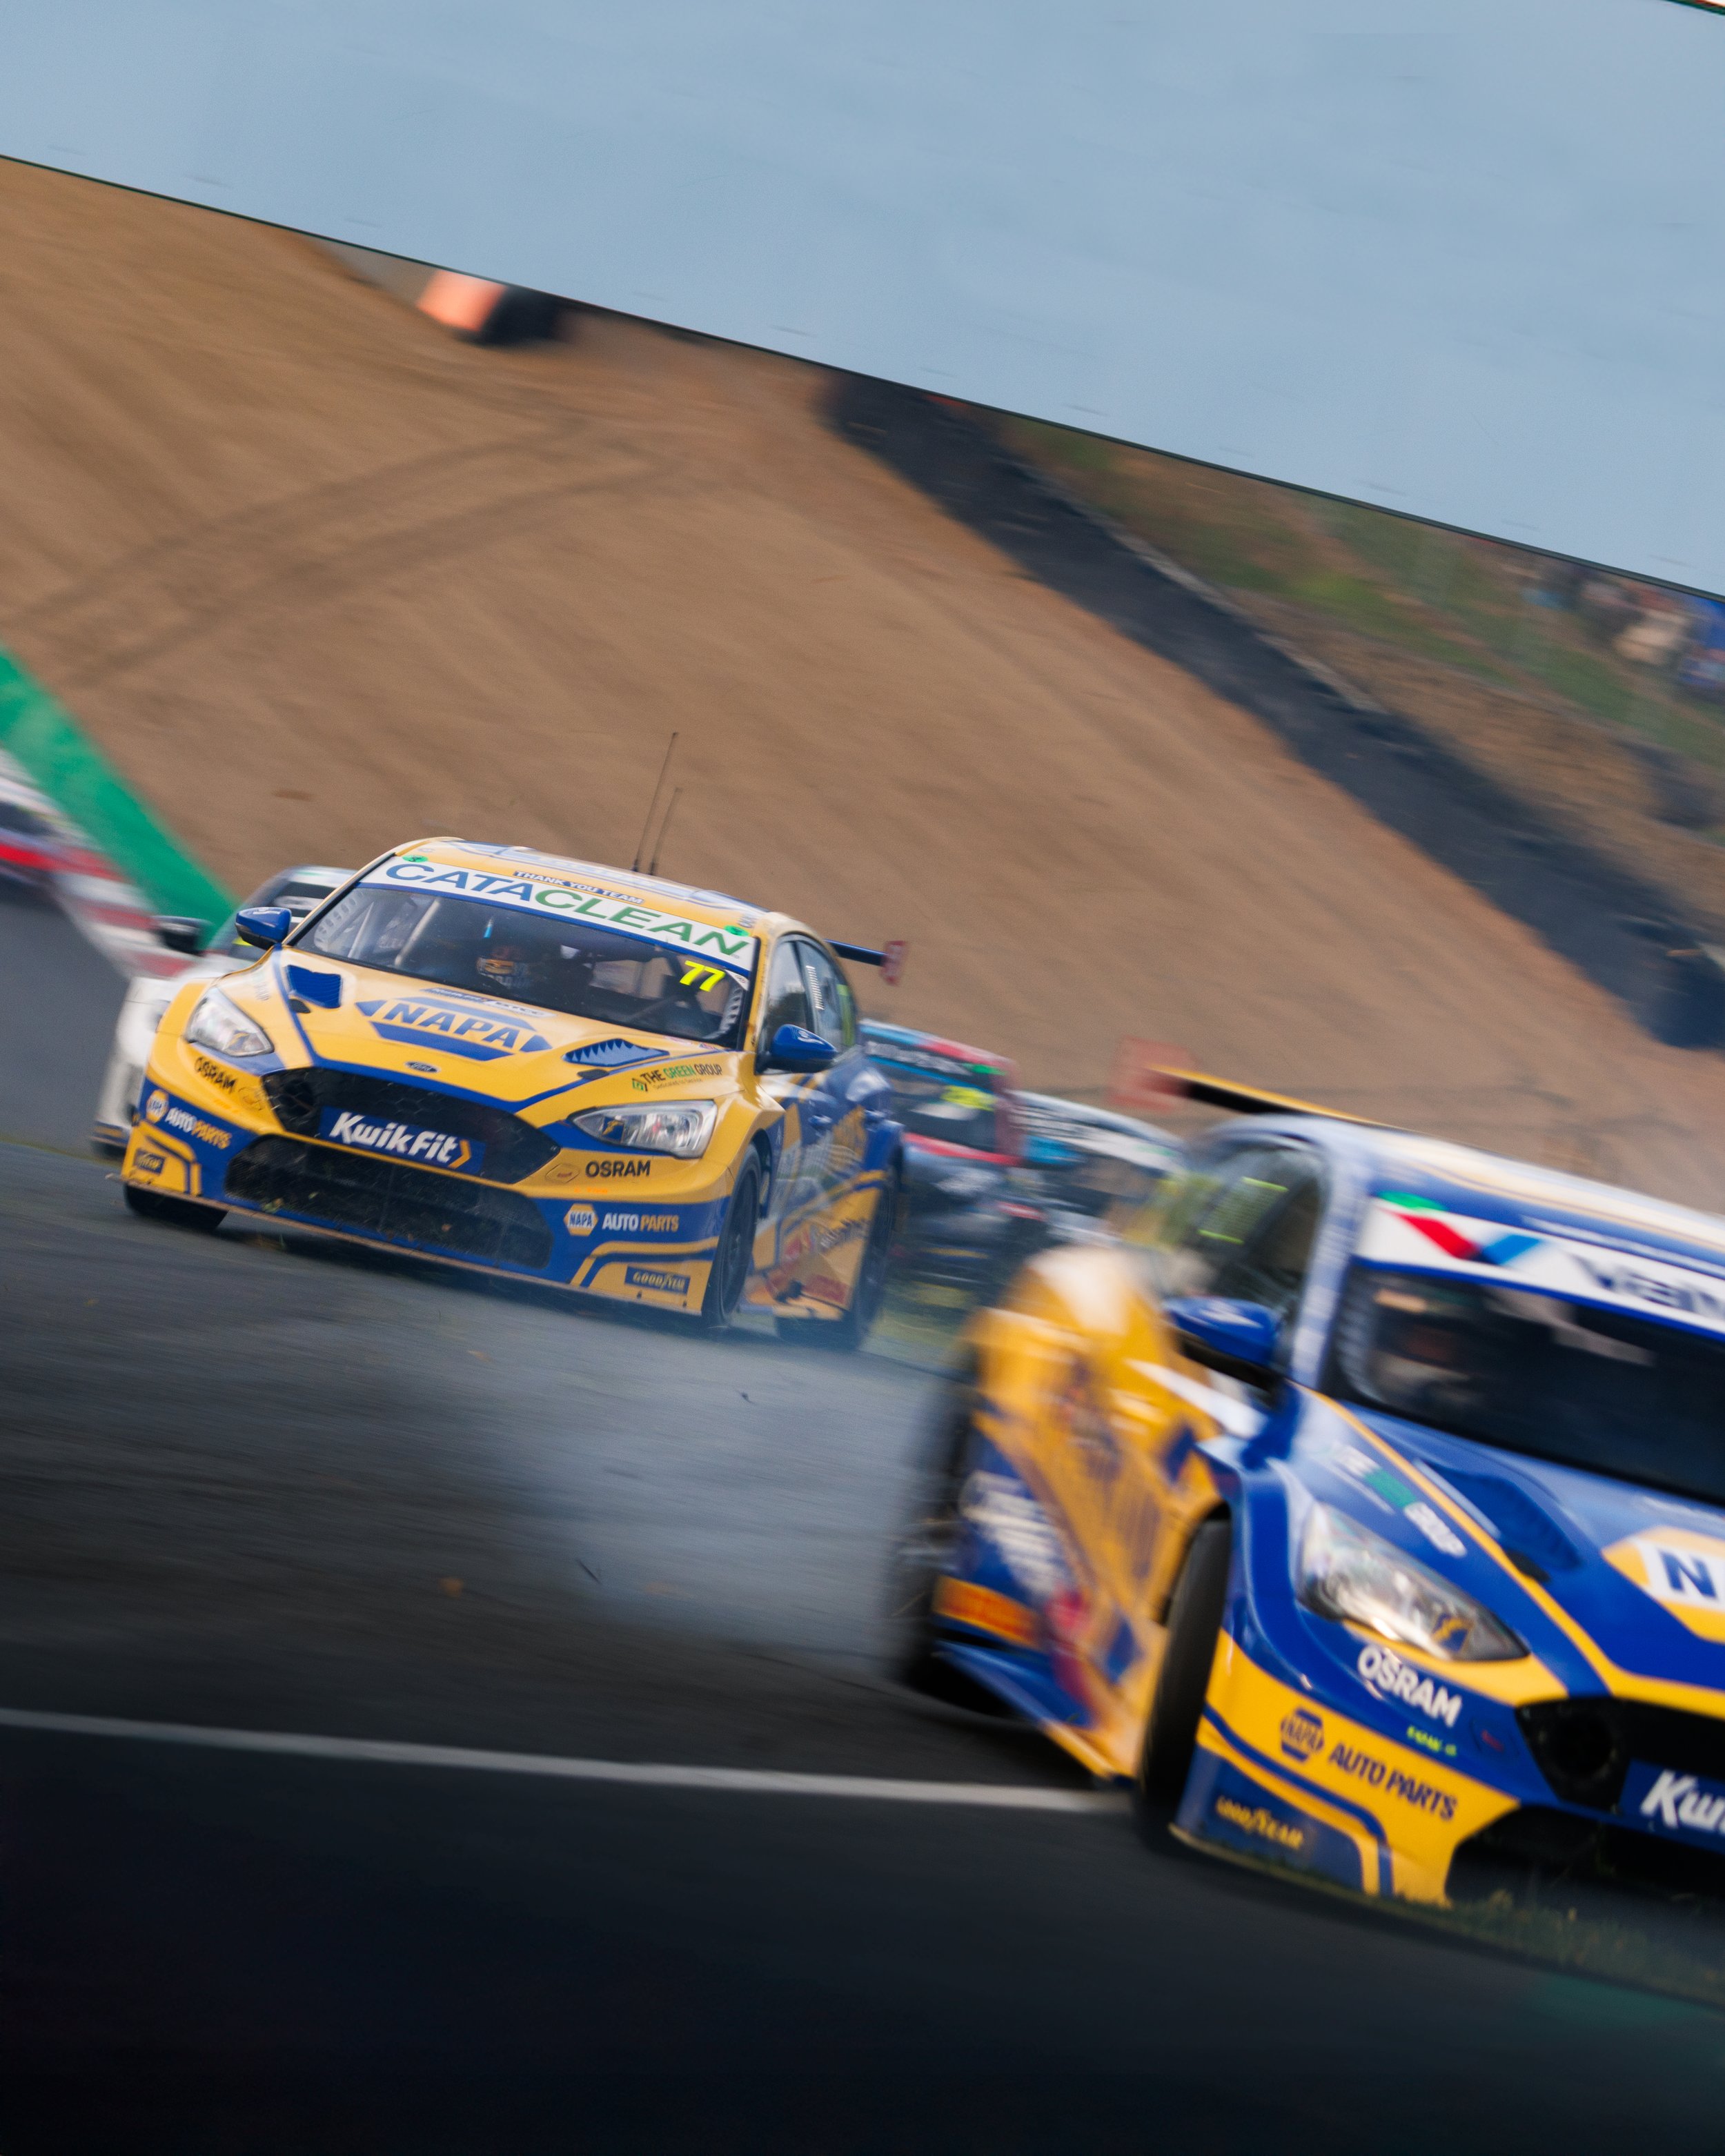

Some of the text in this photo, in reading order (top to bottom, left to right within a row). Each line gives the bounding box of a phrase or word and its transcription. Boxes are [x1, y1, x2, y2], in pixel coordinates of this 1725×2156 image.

[517, 871, 644, 904] THANK YOU TEAM
[386, 863, 749, 956] CATACLEAN
[680, 960, 726, 992] 77
[382, 1002, 520, 1049] NAPA
[194, 1056, 237, 1095] OSRAM
[640, 1069, 666, 1084] THE
[662, 1065, 696, 1079] GREEN
[693, 1063, 722, 1076] GROUP
[165, 1107, 197, 1133] AUTO
[191, 1120, 233, 1149] PARTS
[585, 1160, 651, 1178] OSRAM
[569, 1212, 680, 1232] NAPA AUTO PARTS
[1357, 1643, 1462, 1728] OSRAM
[1329, 1741, 1386, 1788] AUTO
[1386, 1768, 1458, 1822] PARTS
